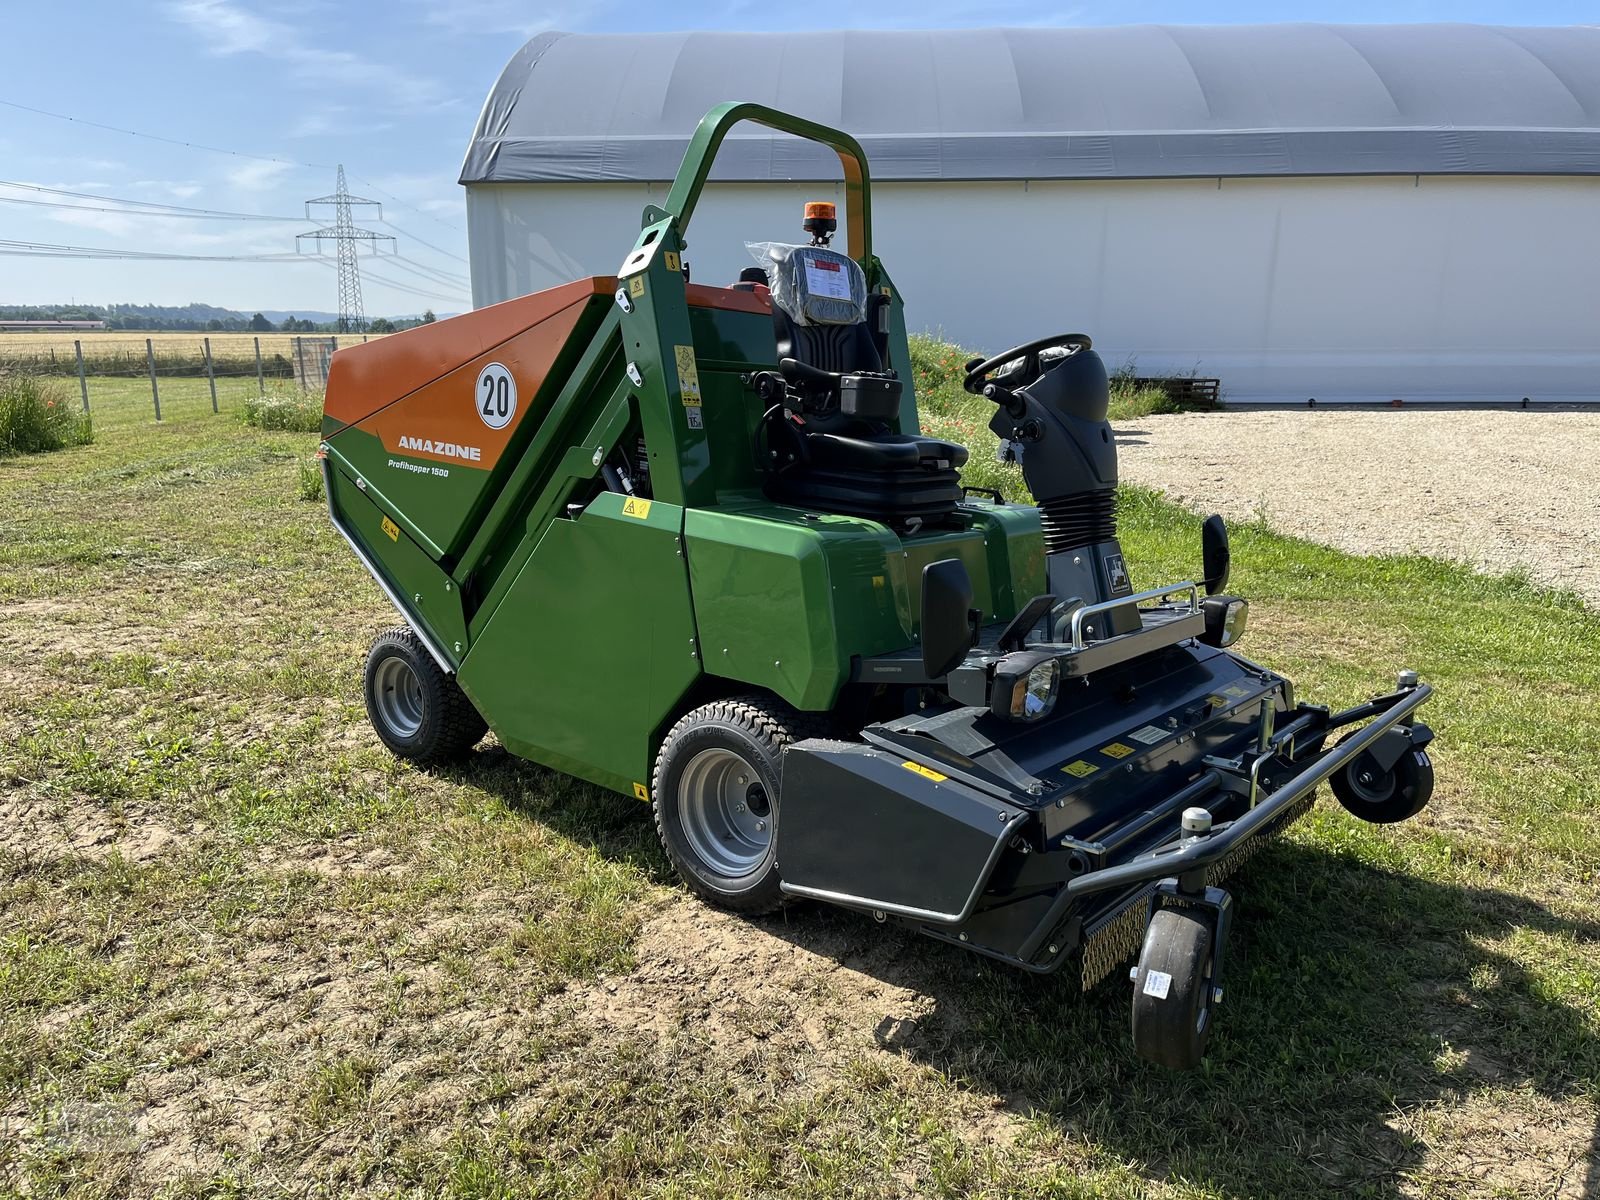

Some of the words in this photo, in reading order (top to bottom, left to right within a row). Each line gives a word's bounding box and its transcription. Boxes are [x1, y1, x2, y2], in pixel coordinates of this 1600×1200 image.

[482, 374, 509, 418] 20
[398, 435, 481, 462] AMAZONE
[388, 459, 430, 475] Profihopper
[431, 467, 449, 478] 1500
